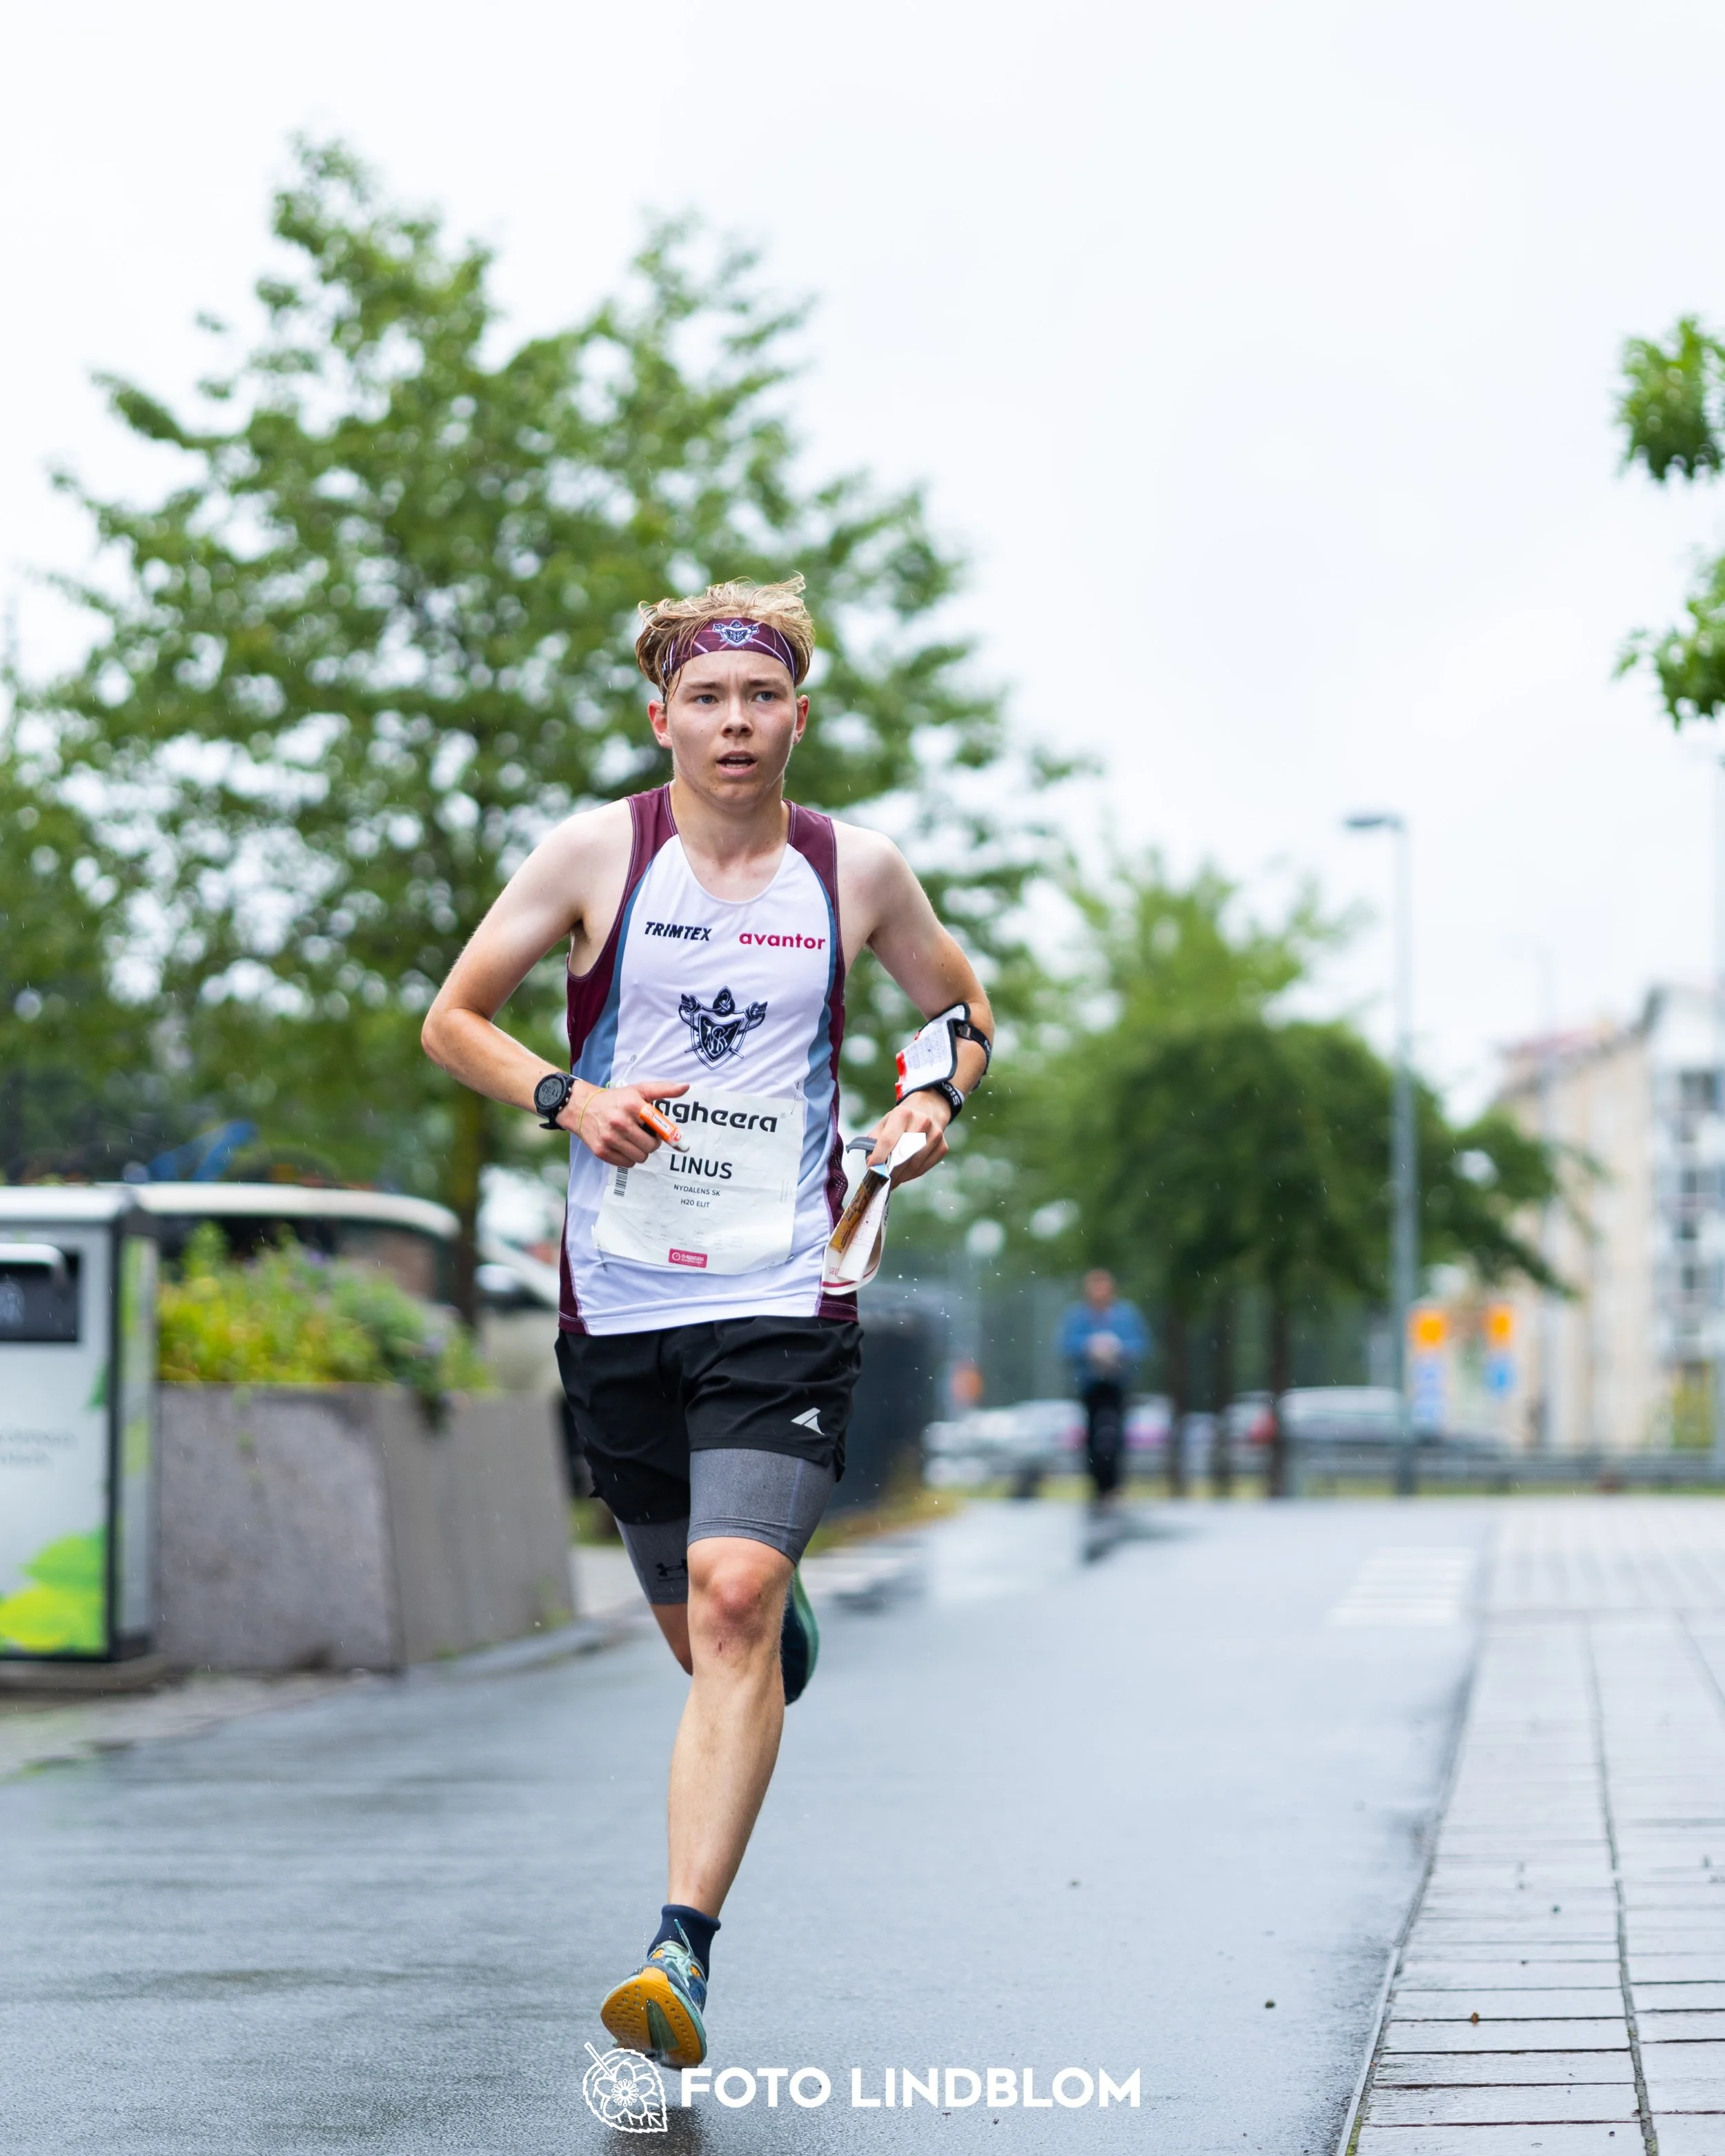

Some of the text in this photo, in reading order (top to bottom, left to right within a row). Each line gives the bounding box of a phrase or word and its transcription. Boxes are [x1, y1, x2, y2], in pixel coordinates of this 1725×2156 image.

[644, 921, 712, 941] TRIMTEX
[739, 933, 826, 949] avantor
[651, 1098, 778, 1133] agheera
[669, 1154, 733, 1180] LINUS
[673, 1184, 710, 1195] NYDALENS
